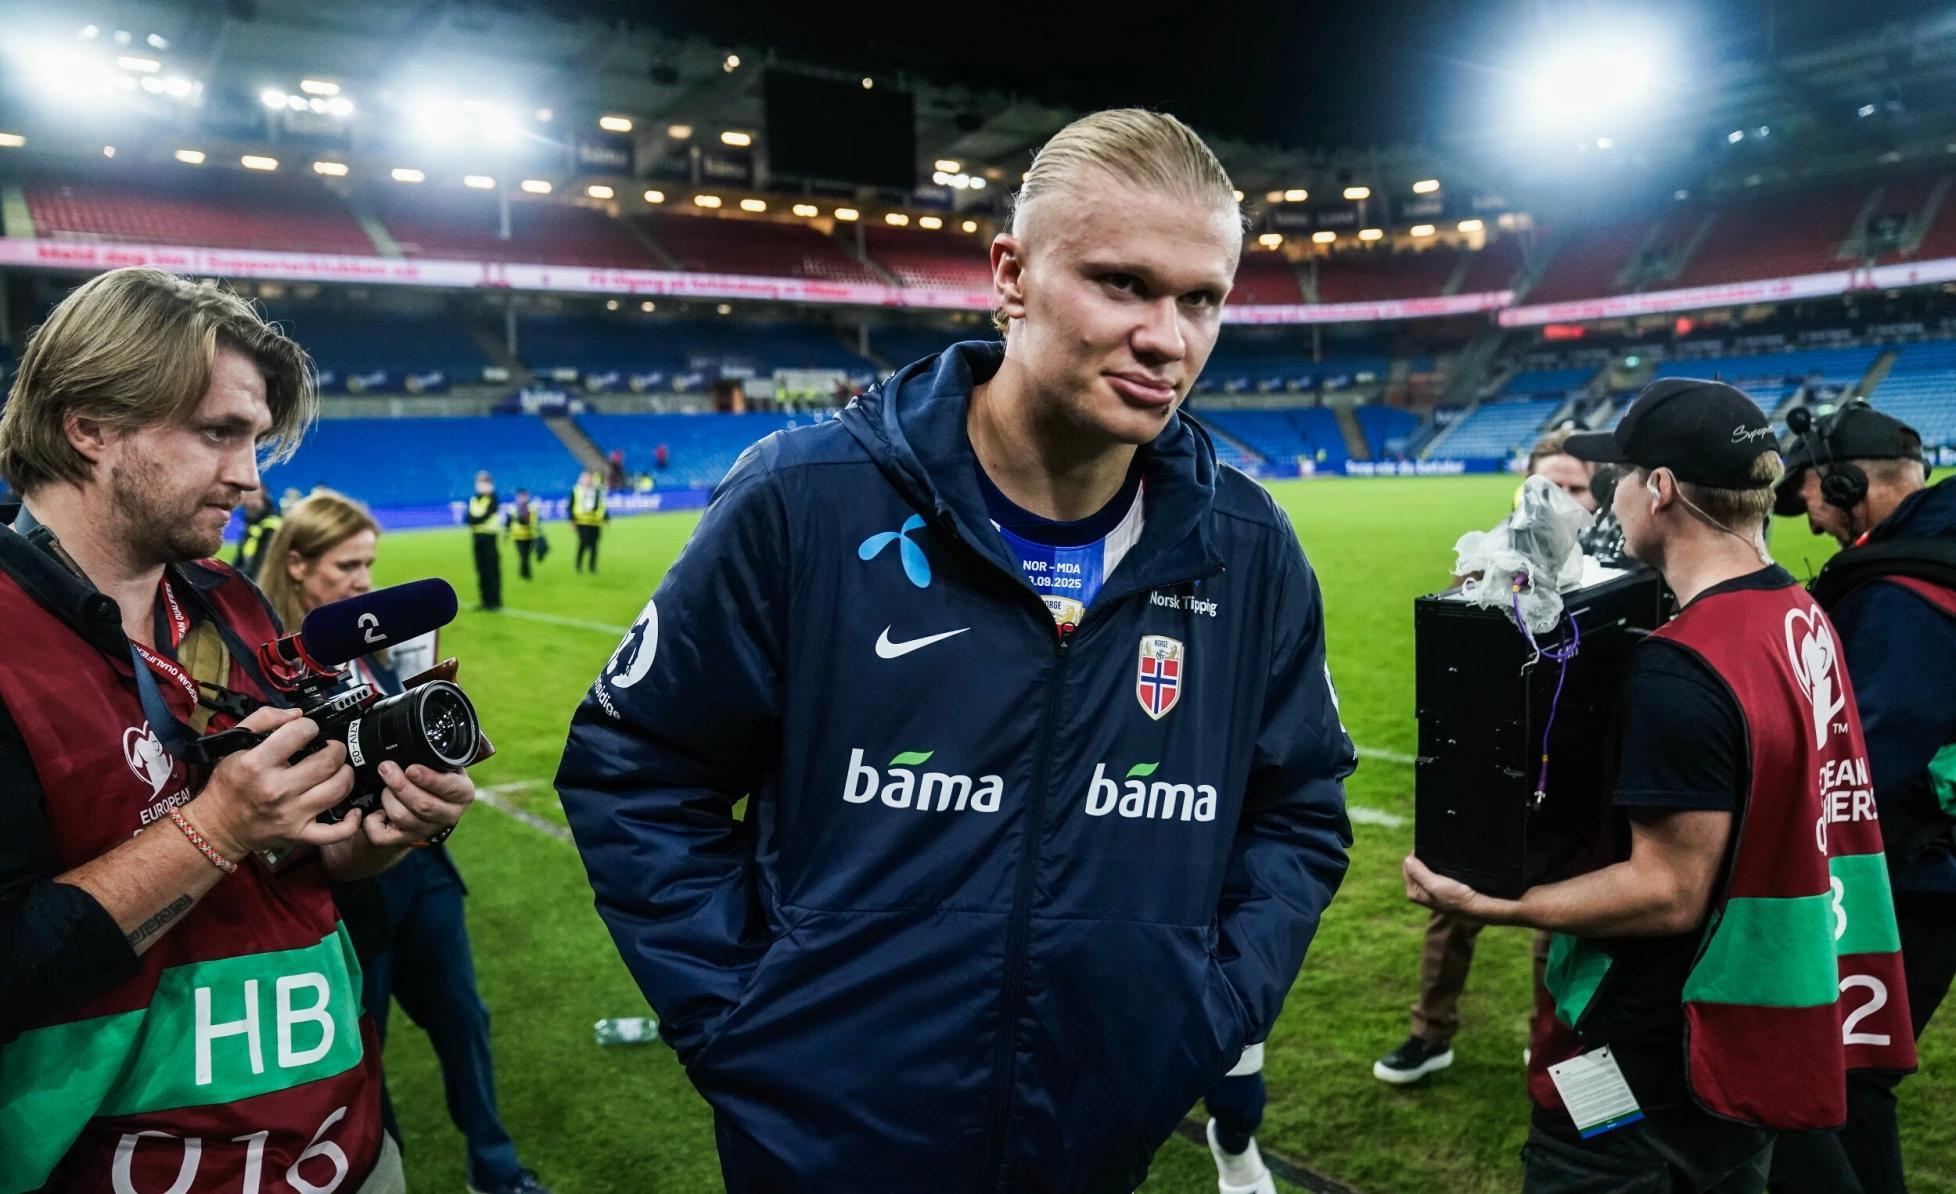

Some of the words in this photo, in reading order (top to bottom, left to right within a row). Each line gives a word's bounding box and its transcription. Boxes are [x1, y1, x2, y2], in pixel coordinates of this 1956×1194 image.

[1023, 560, 1047, 571] NOR
[1056, 562, 1081, 574] MDA
[1029, 575, 1082, 588] .09.2025
[1044, 600, 1061, 609] ORGE
[1150, 590, 1180, 609] Norsk
[357, 612, 387, 644] 2
[133, 644, 178, 676] QUALIFIER
[843, 748, 1004, 813] bama
[1085, 762, 1217, 822] bama
[195, 972, 335, 1086] HB
[111, 1106, 349, 1194] 016
